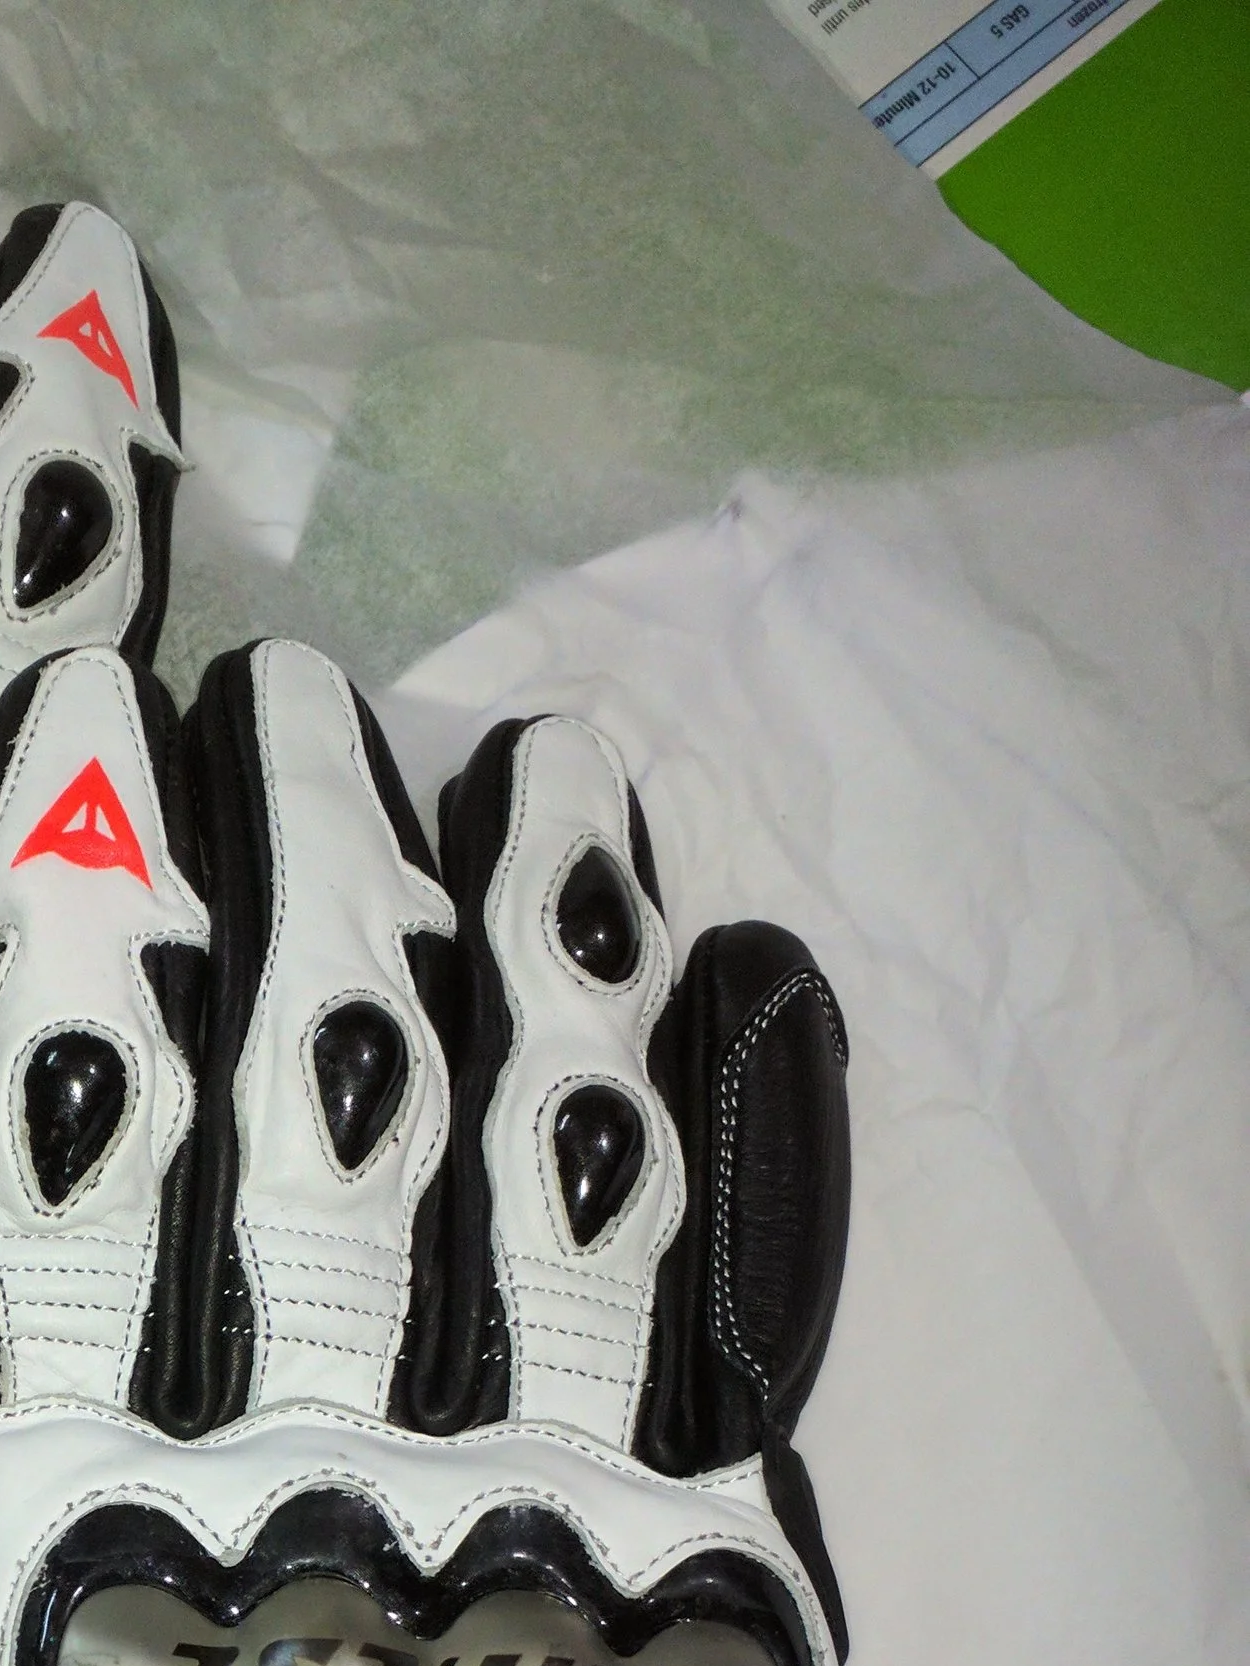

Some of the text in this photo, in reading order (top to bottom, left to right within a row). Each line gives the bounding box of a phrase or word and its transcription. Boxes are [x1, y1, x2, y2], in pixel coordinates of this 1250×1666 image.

[820, 8, 849, 37] until
[990, 4, 1030, 39] GAS 5
[920, 61, 957, 95] 10-12
